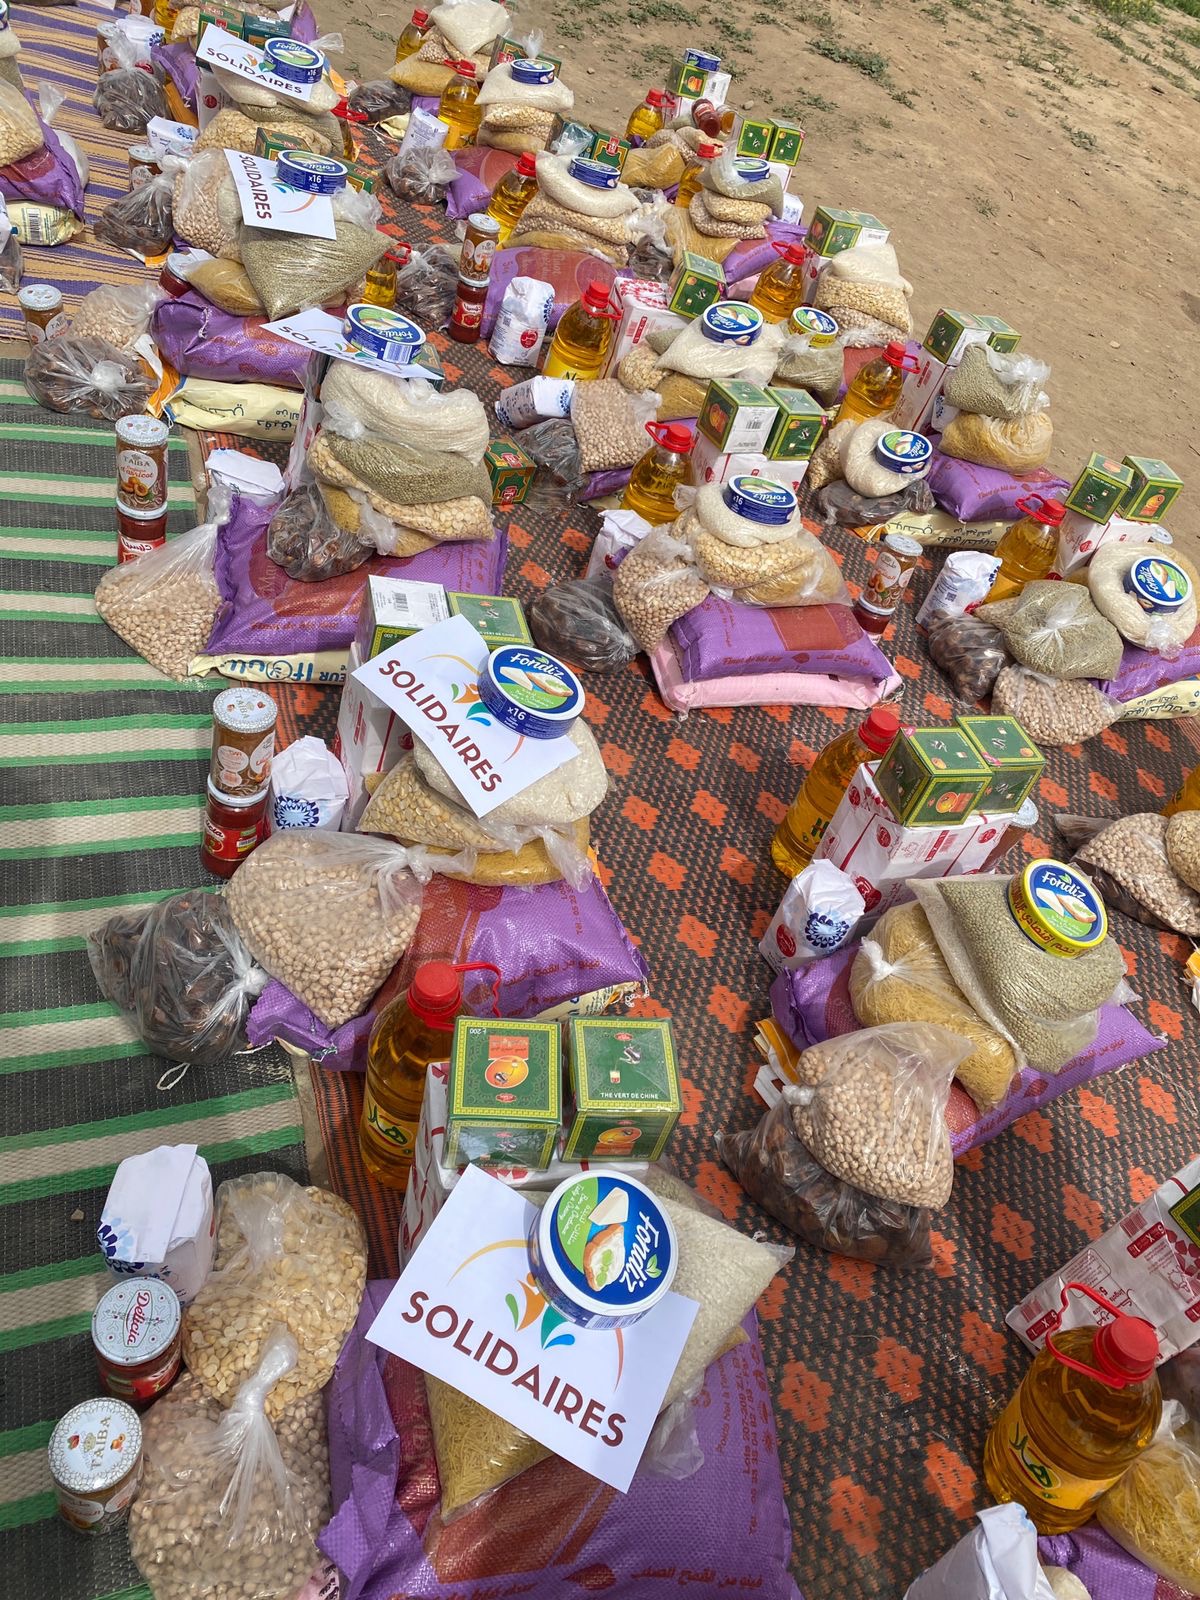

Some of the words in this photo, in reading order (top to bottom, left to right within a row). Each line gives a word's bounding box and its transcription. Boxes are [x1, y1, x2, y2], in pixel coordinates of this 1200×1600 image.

[206, 47, 303, 94] SOLIDAIRES
[239, 153, 272, 221] SOLIDAIRES
[308, 175, 322, 184] x16
[378, 328, 414, 340] Fondiz
[257, 420, 292, 432] دقيق
[123, 455, 151, 468] TAIBA
[752, 491, 788, 504] Fondiz
[1142, 564, 1164, 595] Fondiz
[510, 652, 565, 680] Fondiz
[379, 660, 502, 792] SOLIDAIRES
[507, 706, 527, 721] x16
[1041, 871, 1087, 902] Fondiz
[1147, 1232, 1155, 1243] X
[1157, 1224, 1166, 1236] 5
[619, 1211, 660, 1292] Fondiz
[127, 1291, 150, 1346] Délicia
[1042, 1317, 1050, 1328] X
[401, 1291, 626, 1447] SOLIDAIRES
[91, 1414, 112, 1471] TAIBA
